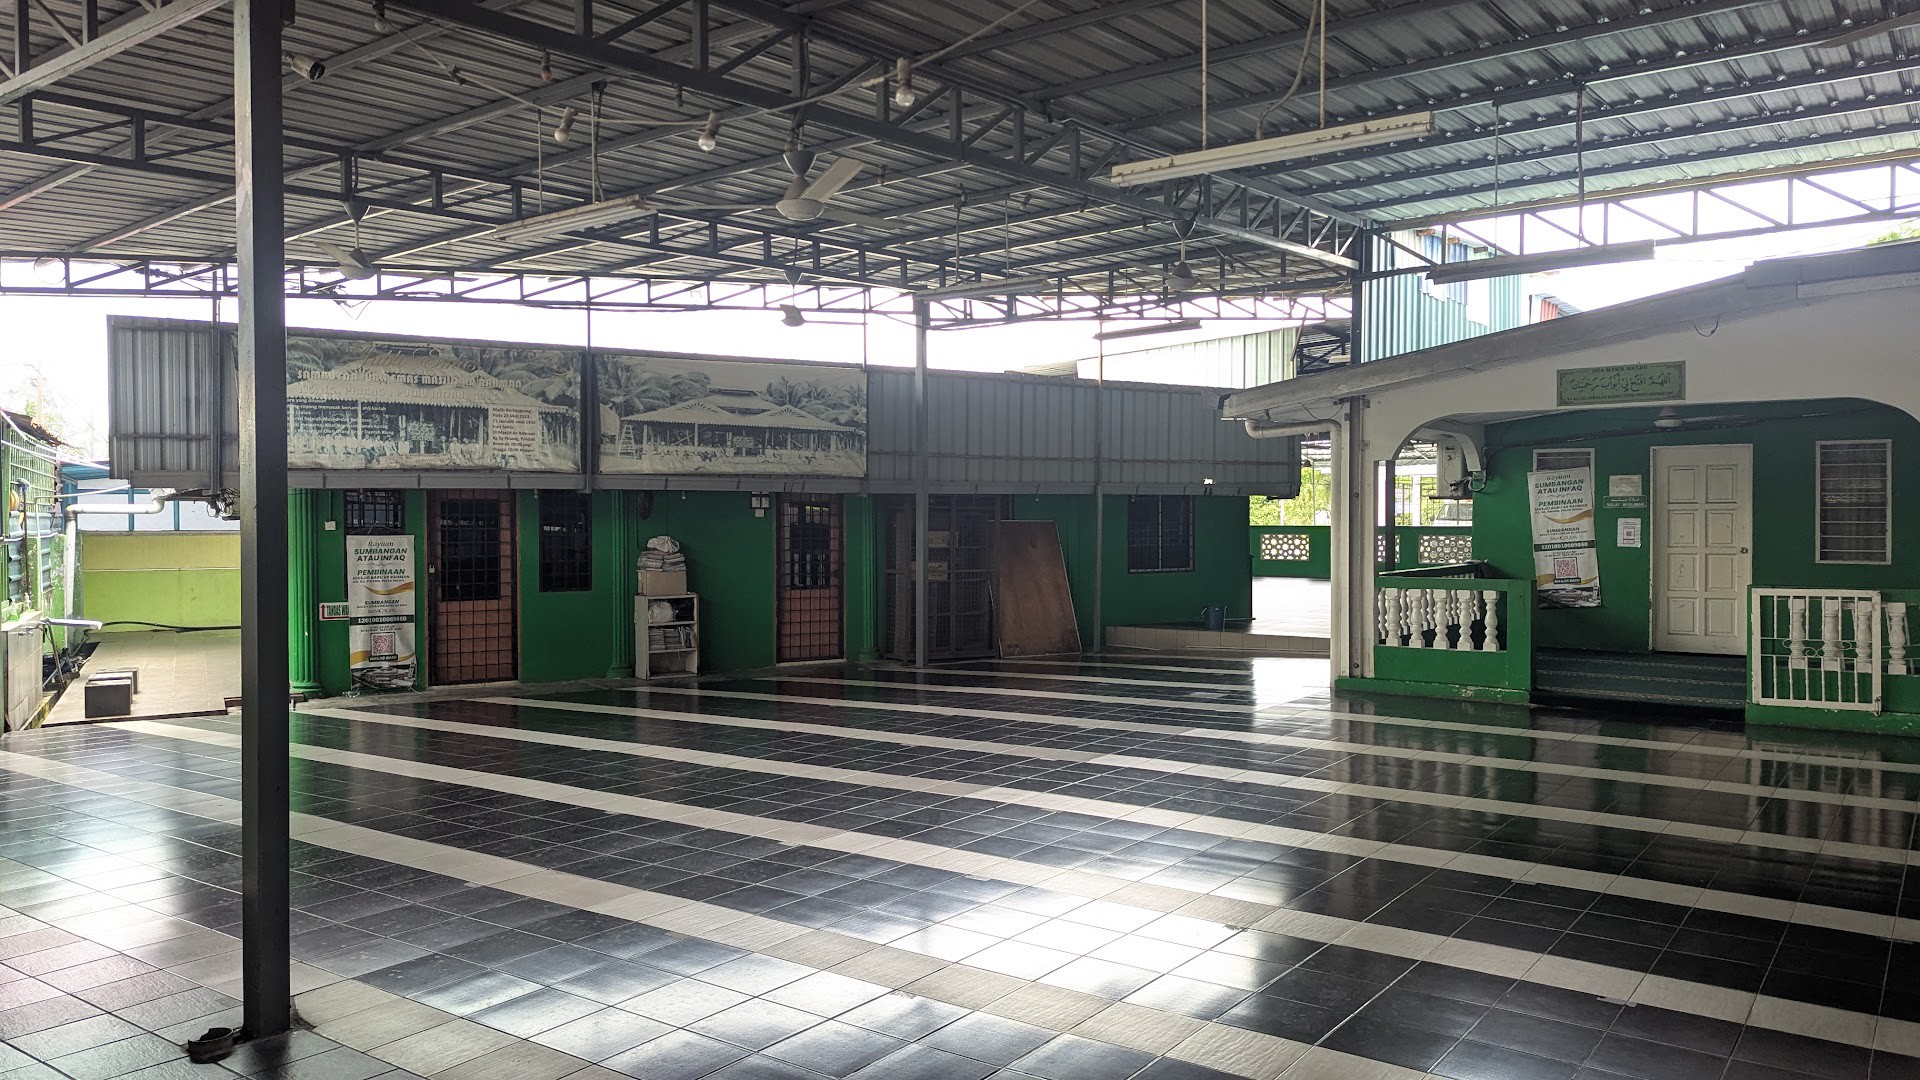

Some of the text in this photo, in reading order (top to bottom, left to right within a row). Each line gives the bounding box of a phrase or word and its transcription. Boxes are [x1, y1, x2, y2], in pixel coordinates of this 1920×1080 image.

[393, 373, 419, 385] EMAS
[1534, 479, 1584, 489] SUMBANGAN
[1559, 485, 1583, 493] INFAQ
[1538, 498, 1584, 507] PEMBINAAN
[368, 541, 395, 549] Rayuan
[380, 554, 406, 562] INFAQ
[357, 568, 406, 576] PEMBINAAN
